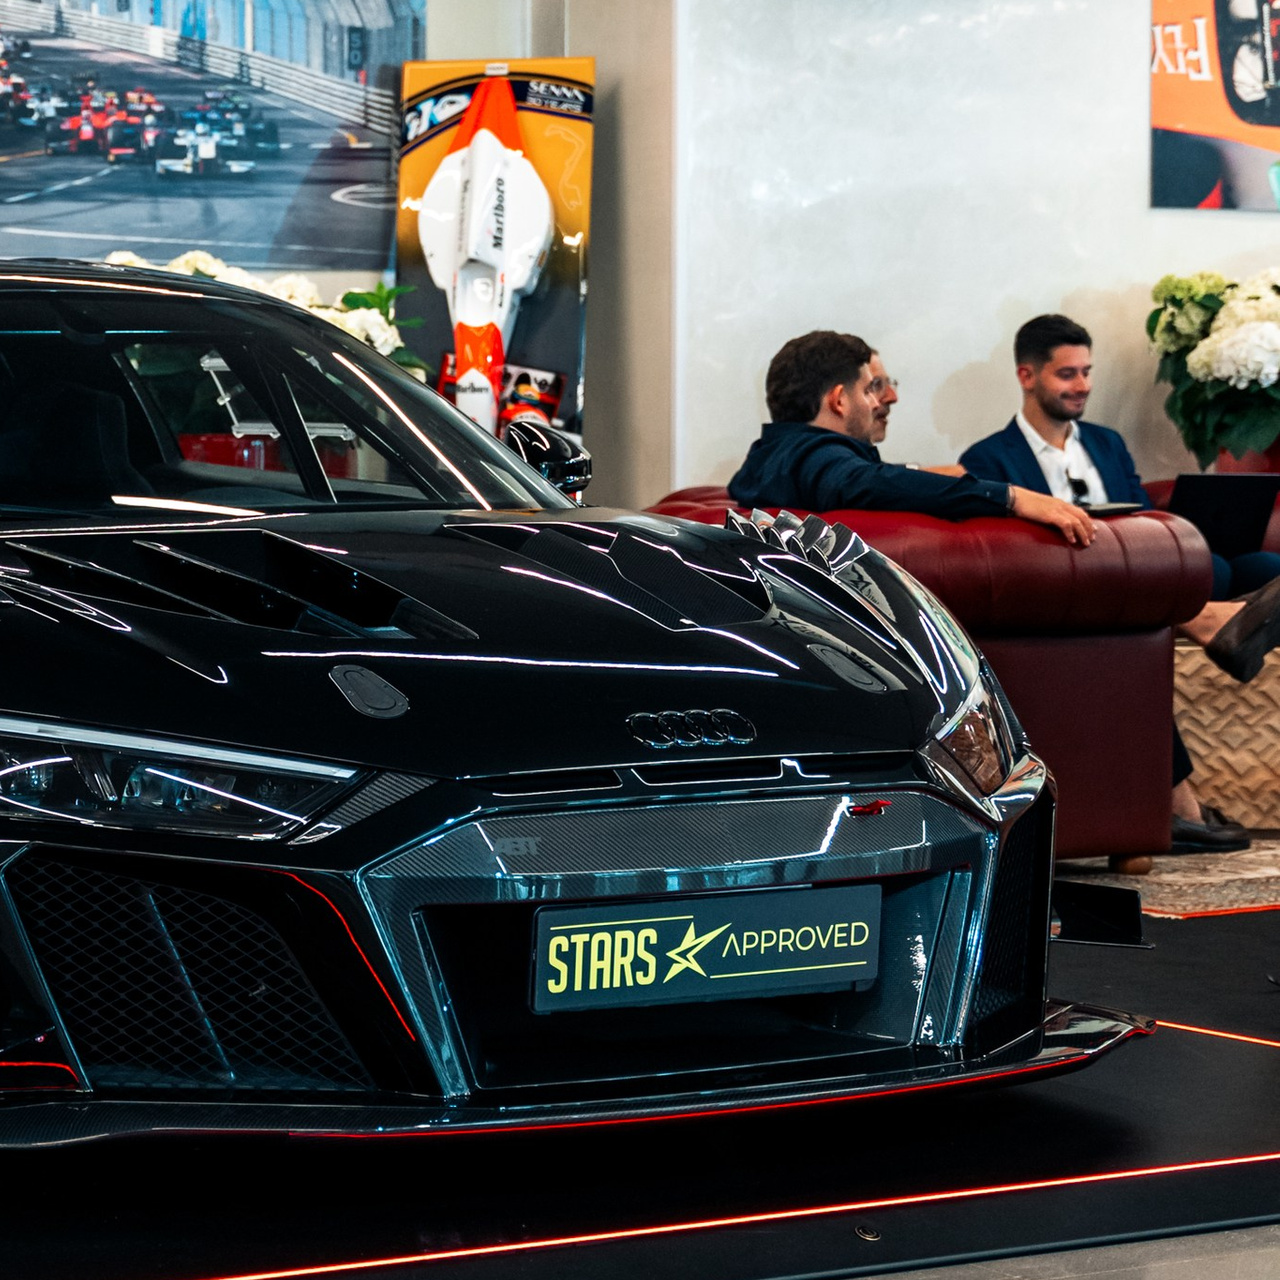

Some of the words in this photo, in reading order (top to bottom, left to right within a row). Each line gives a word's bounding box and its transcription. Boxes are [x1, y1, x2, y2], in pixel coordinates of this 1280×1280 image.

[495, 836, 541, 856] ABT
[547, 927, 658, 995] STARS
[721, 921, 870, 959] APPROVED
